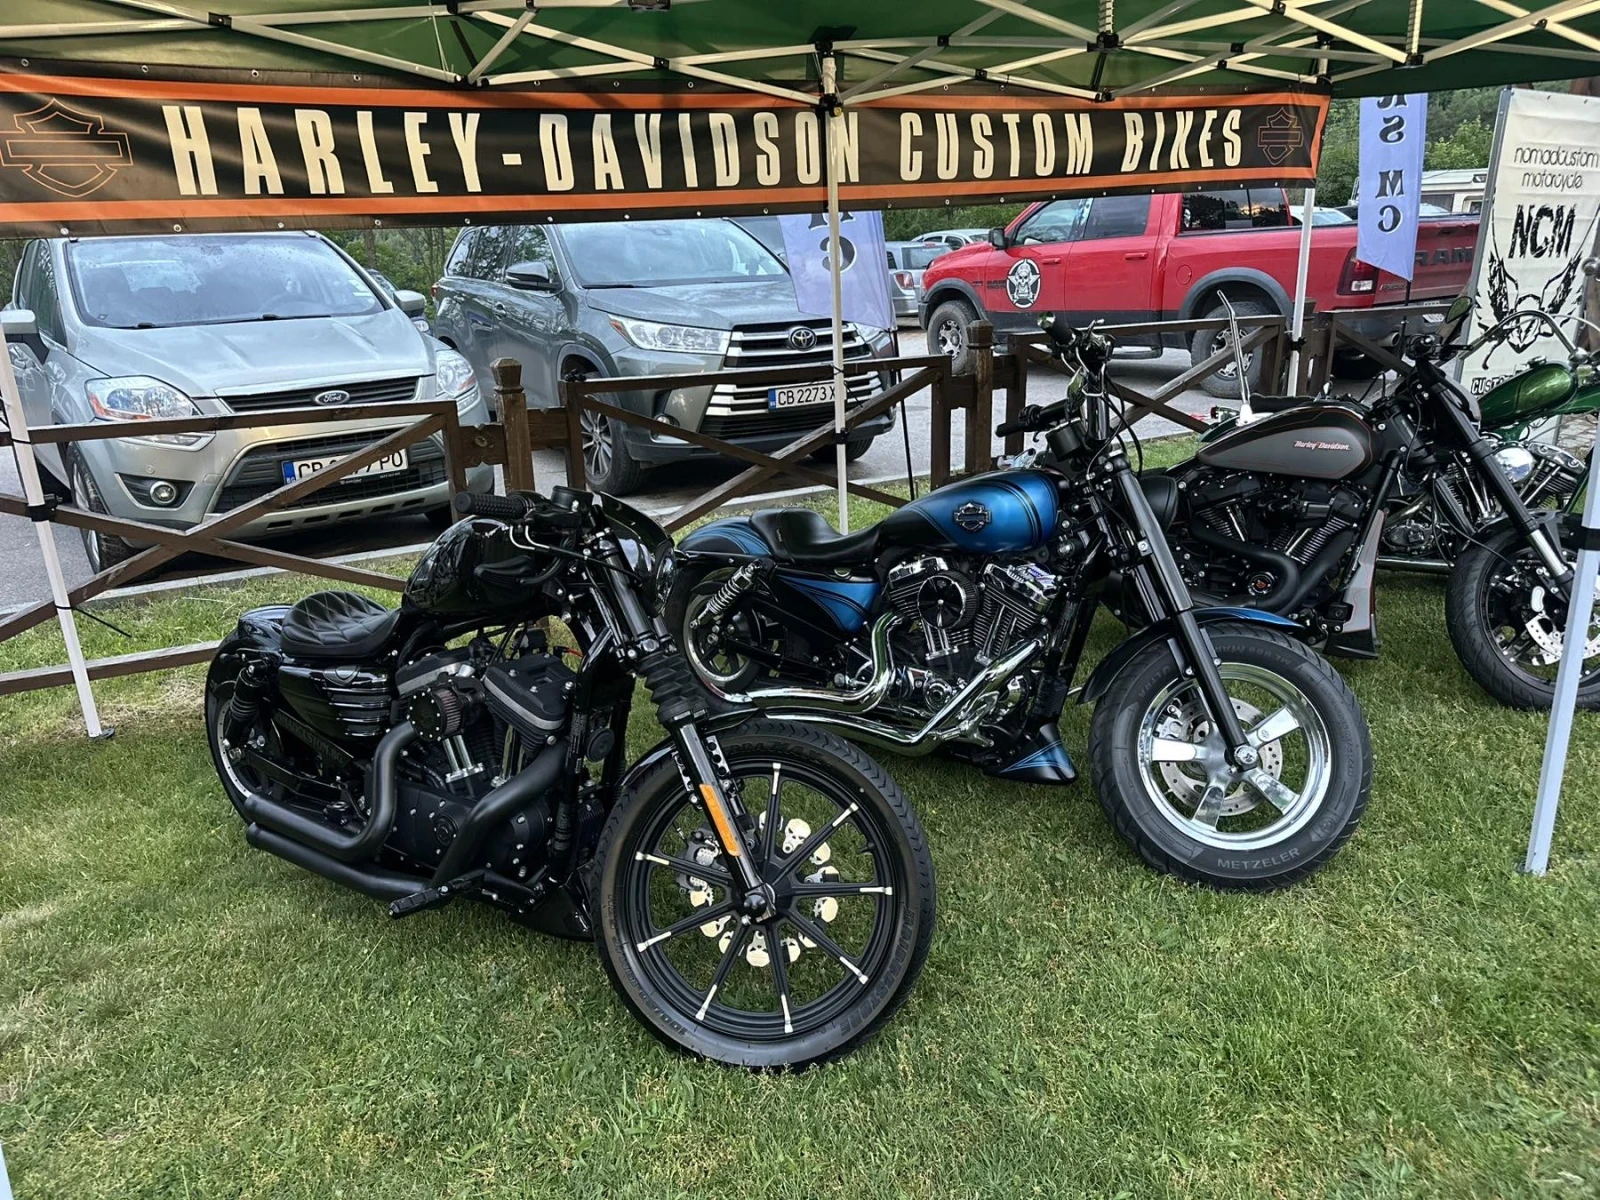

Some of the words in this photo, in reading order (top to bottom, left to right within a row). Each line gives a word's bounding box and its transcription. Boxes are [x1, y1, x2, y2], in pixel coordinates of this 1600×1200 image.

[162, 105, 859, 195] HARLEY-DAVIDSON
[900, 112, 1093, 181] CUSTOM
[1121, 109, 1242, 172] BIKES
[1514, 146, 1599, 168] nomadcustom
[1522, 170, 1582, 192] motorcycle
[1508, 204, 1576, 259] NCM
[323, 393, 342, 402] Ford
[778, 390, 794, 405] CB
[797, 386, 827, 403] 2273
[1217, 847, 1301, 870] METZELER
